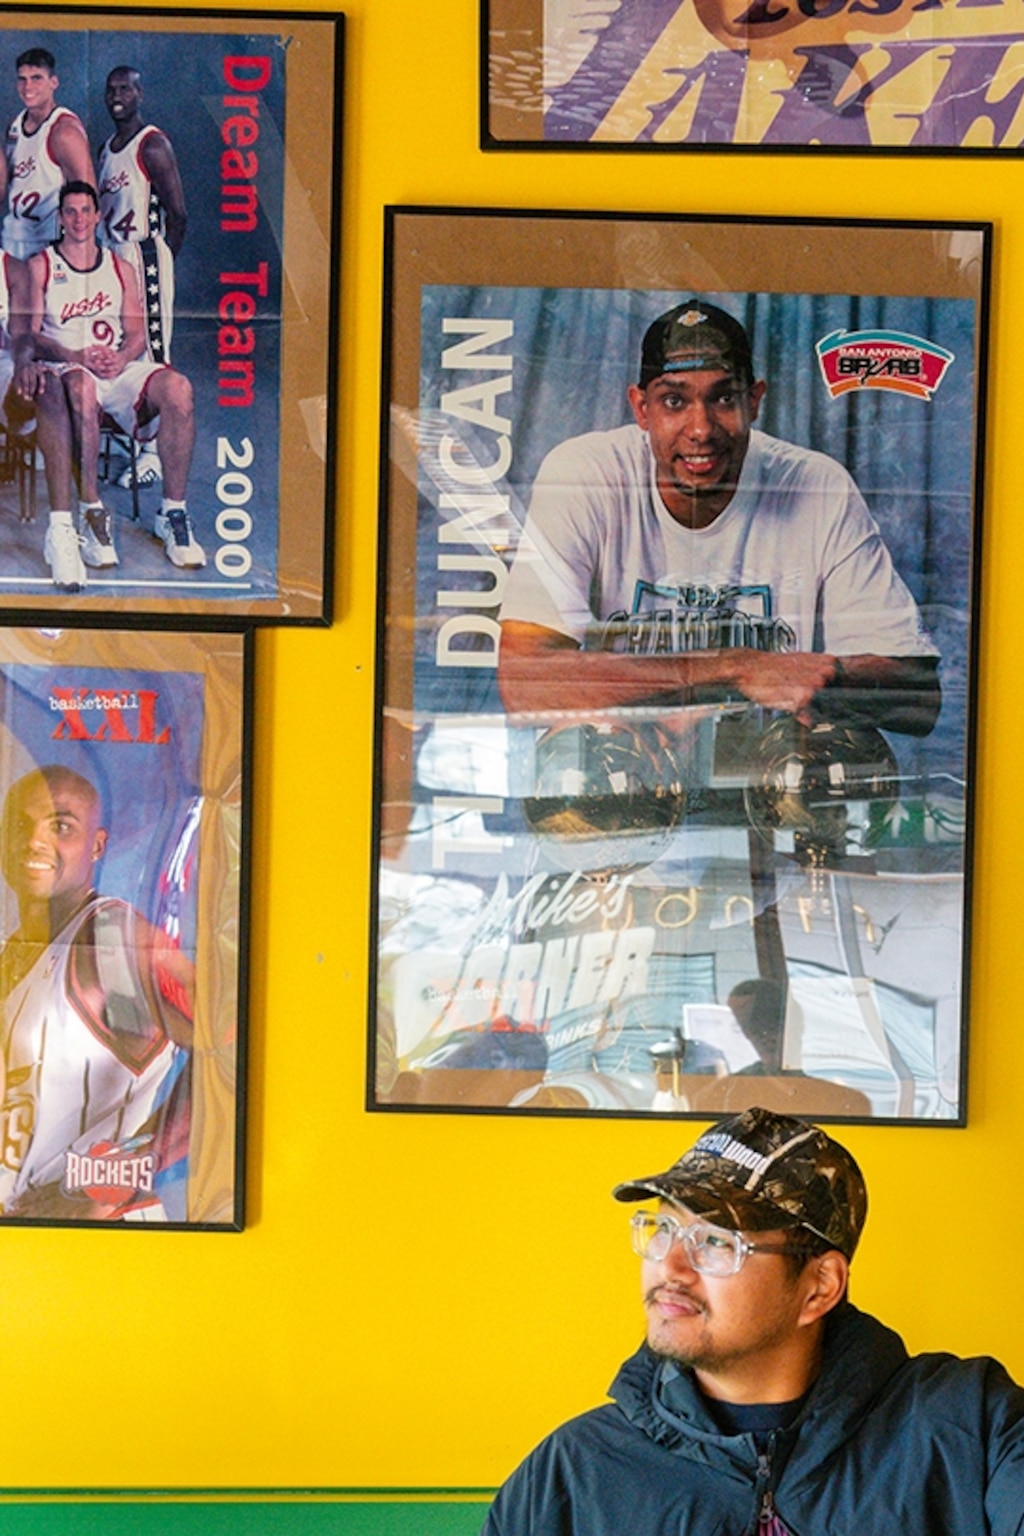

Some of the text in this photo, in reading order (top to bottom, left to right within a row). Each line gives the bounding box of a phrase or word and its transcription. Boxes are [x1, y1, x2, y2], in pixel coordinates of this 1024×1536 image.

[12, 192, 41, 221] 12
[105, 207, 137, 241] 14
[92, 320, 115, 346] 9
[215, 56, 271, 578] Dream Team 2000
[838, 347, 923, 358] SAN ANTONIO
[436, 318, 513, 667] DUNCAN
[48, 693, 139, 711] basketball
[51, 686, 171, 745] XXL
[471, 869, 635, 937] Mike's
[65, 1151, 153, 1192] ROCKETS
